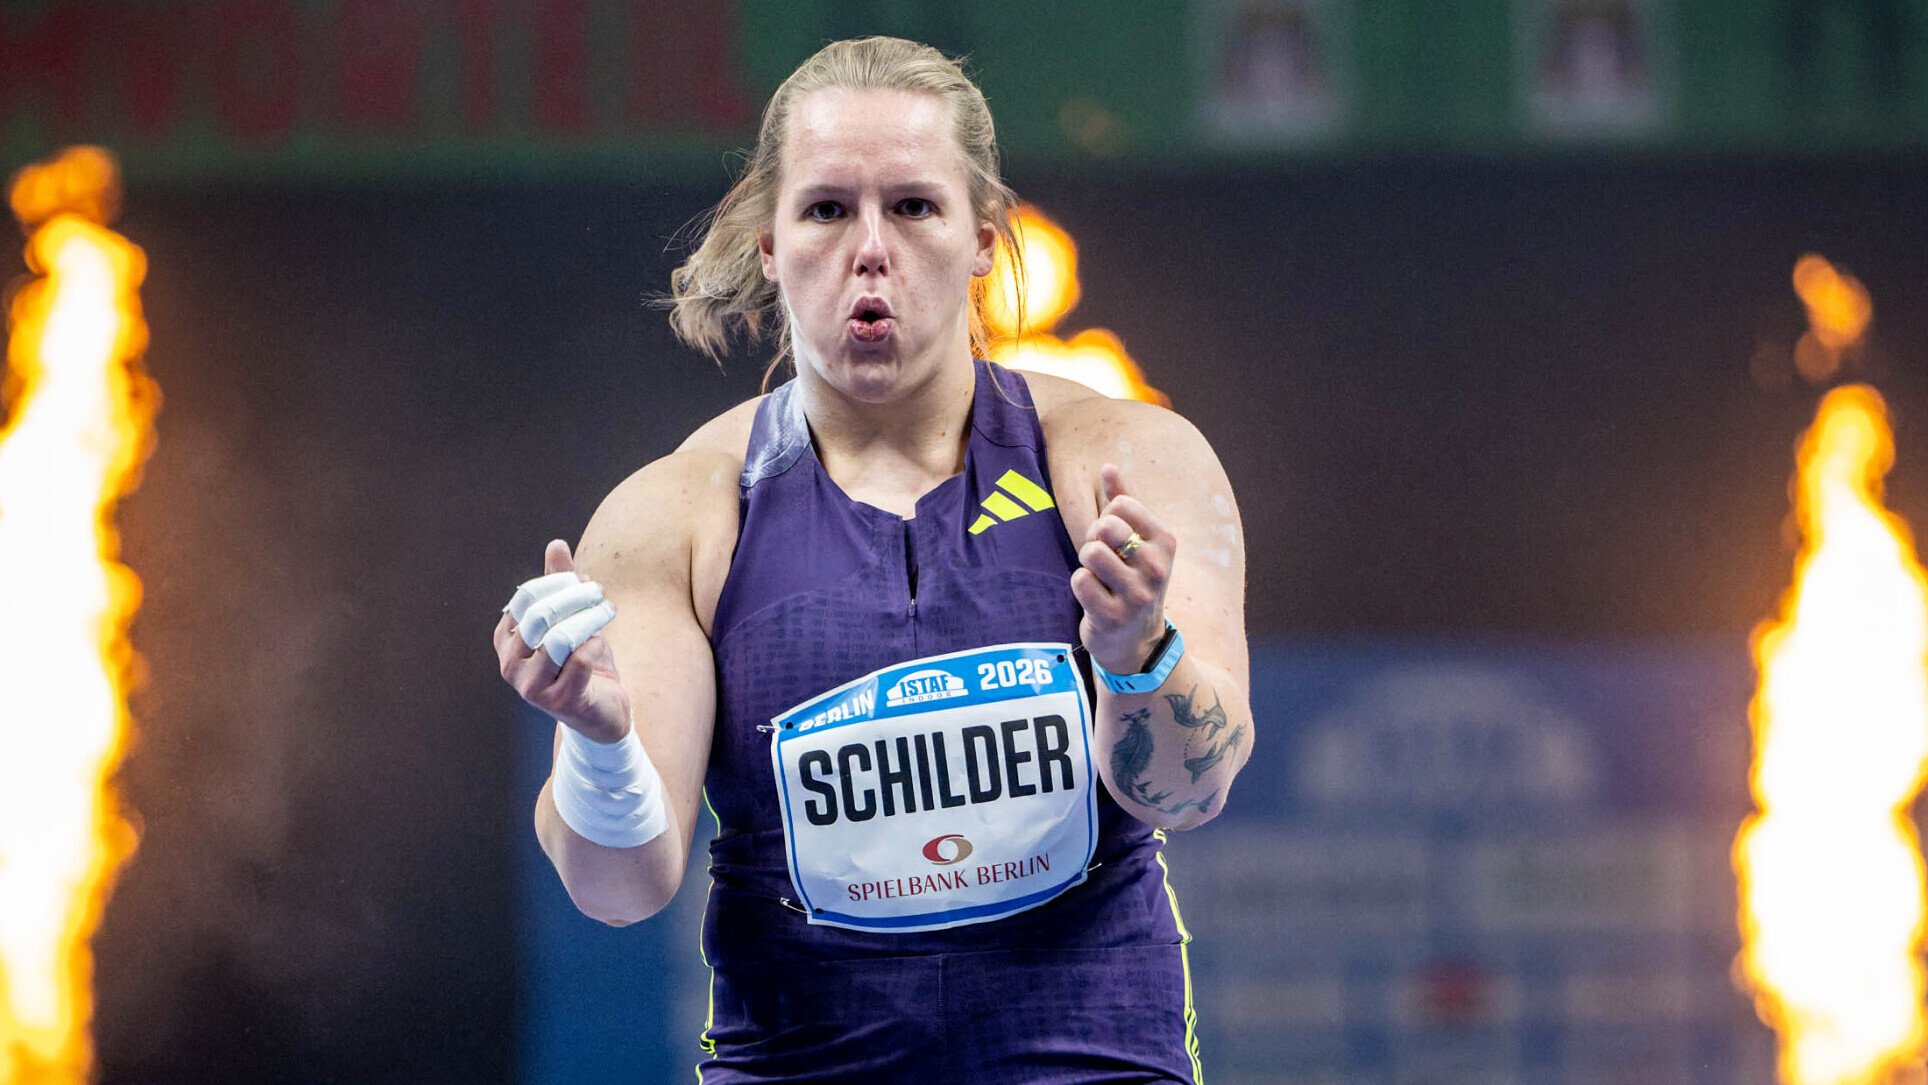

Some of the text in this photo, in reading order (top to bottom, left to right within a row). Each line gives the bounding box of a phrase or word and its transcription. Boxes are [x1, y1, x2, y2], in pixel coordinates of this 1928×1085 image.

[900, 675, 949, 698] ISTAF
[978, 659, 1053, 691] 2026
[798, 689, 876, 732] BERLIN
[902, 691, 953, 704] INDOOR
[798, 714, 1076, 827] SCHILDER
[848, 853, 1051, 902] SPIELBANK BERLIN
